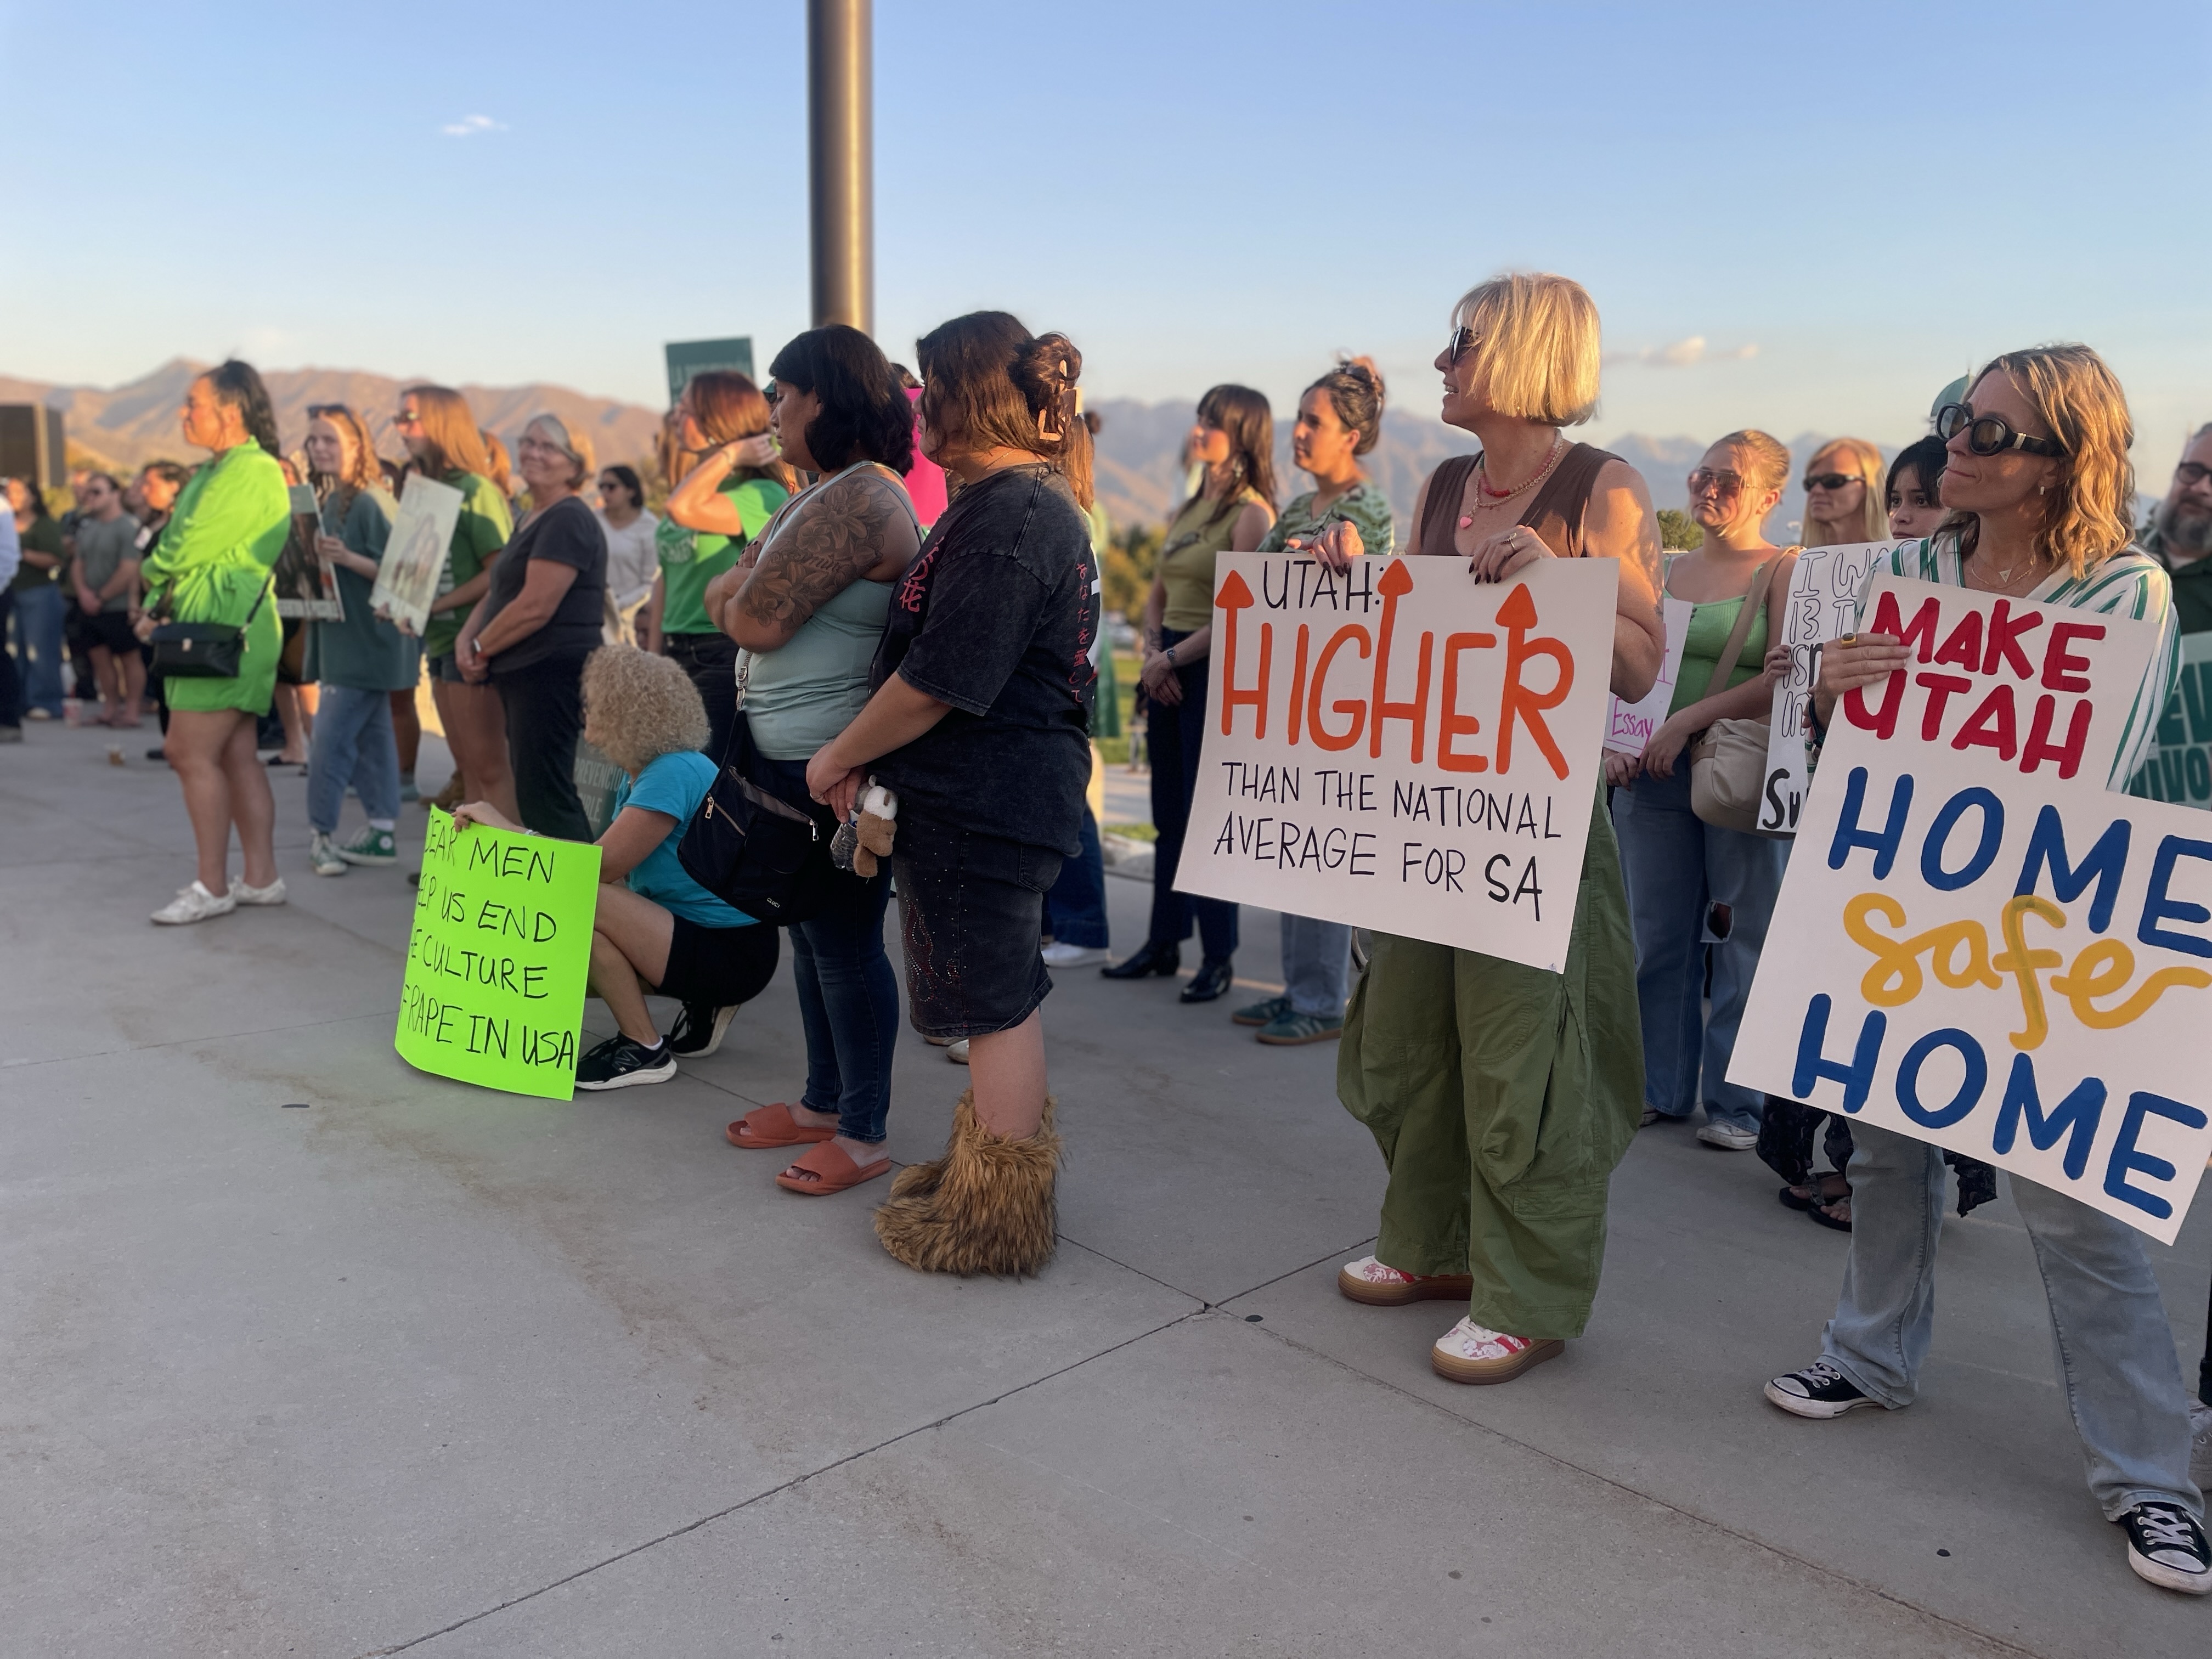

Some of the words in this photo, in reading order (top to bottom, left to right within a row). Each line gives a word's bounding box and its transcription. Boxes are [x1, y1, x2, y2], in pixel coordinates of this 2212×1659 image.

[1263, 560, 1384, 613] UTAH:
[1216, 587, 1574, 780] HIGHER
[1870, 591, 2106, 693] MAKE
[1843, 669, 2094, 779] UTAH
[1221, 762, 1300, 804] THAN
[1314, 770, 1377, 811] THE
[1393, 780, 1561, 839] NATIONAL
[469, 837, 554, 883] MEN
[1214, 810, 1376, 876] AVERAGE
[1403, 842, 1465, 893] FOR
[1484, 853, 1543, 922] SA
[1827, 766, 2212, 958] HOME
[442, 886, 465, 923] US
[478, 900, 556, 943] END
[423, 935, 549, 999] CULTURE
[408, 985, 463, 1043] RAPE
[466, 1015, 509, 1059] IN
[522, 1025, 574, 1071] USA
[1792, 993, 2208, 1220] HOME
